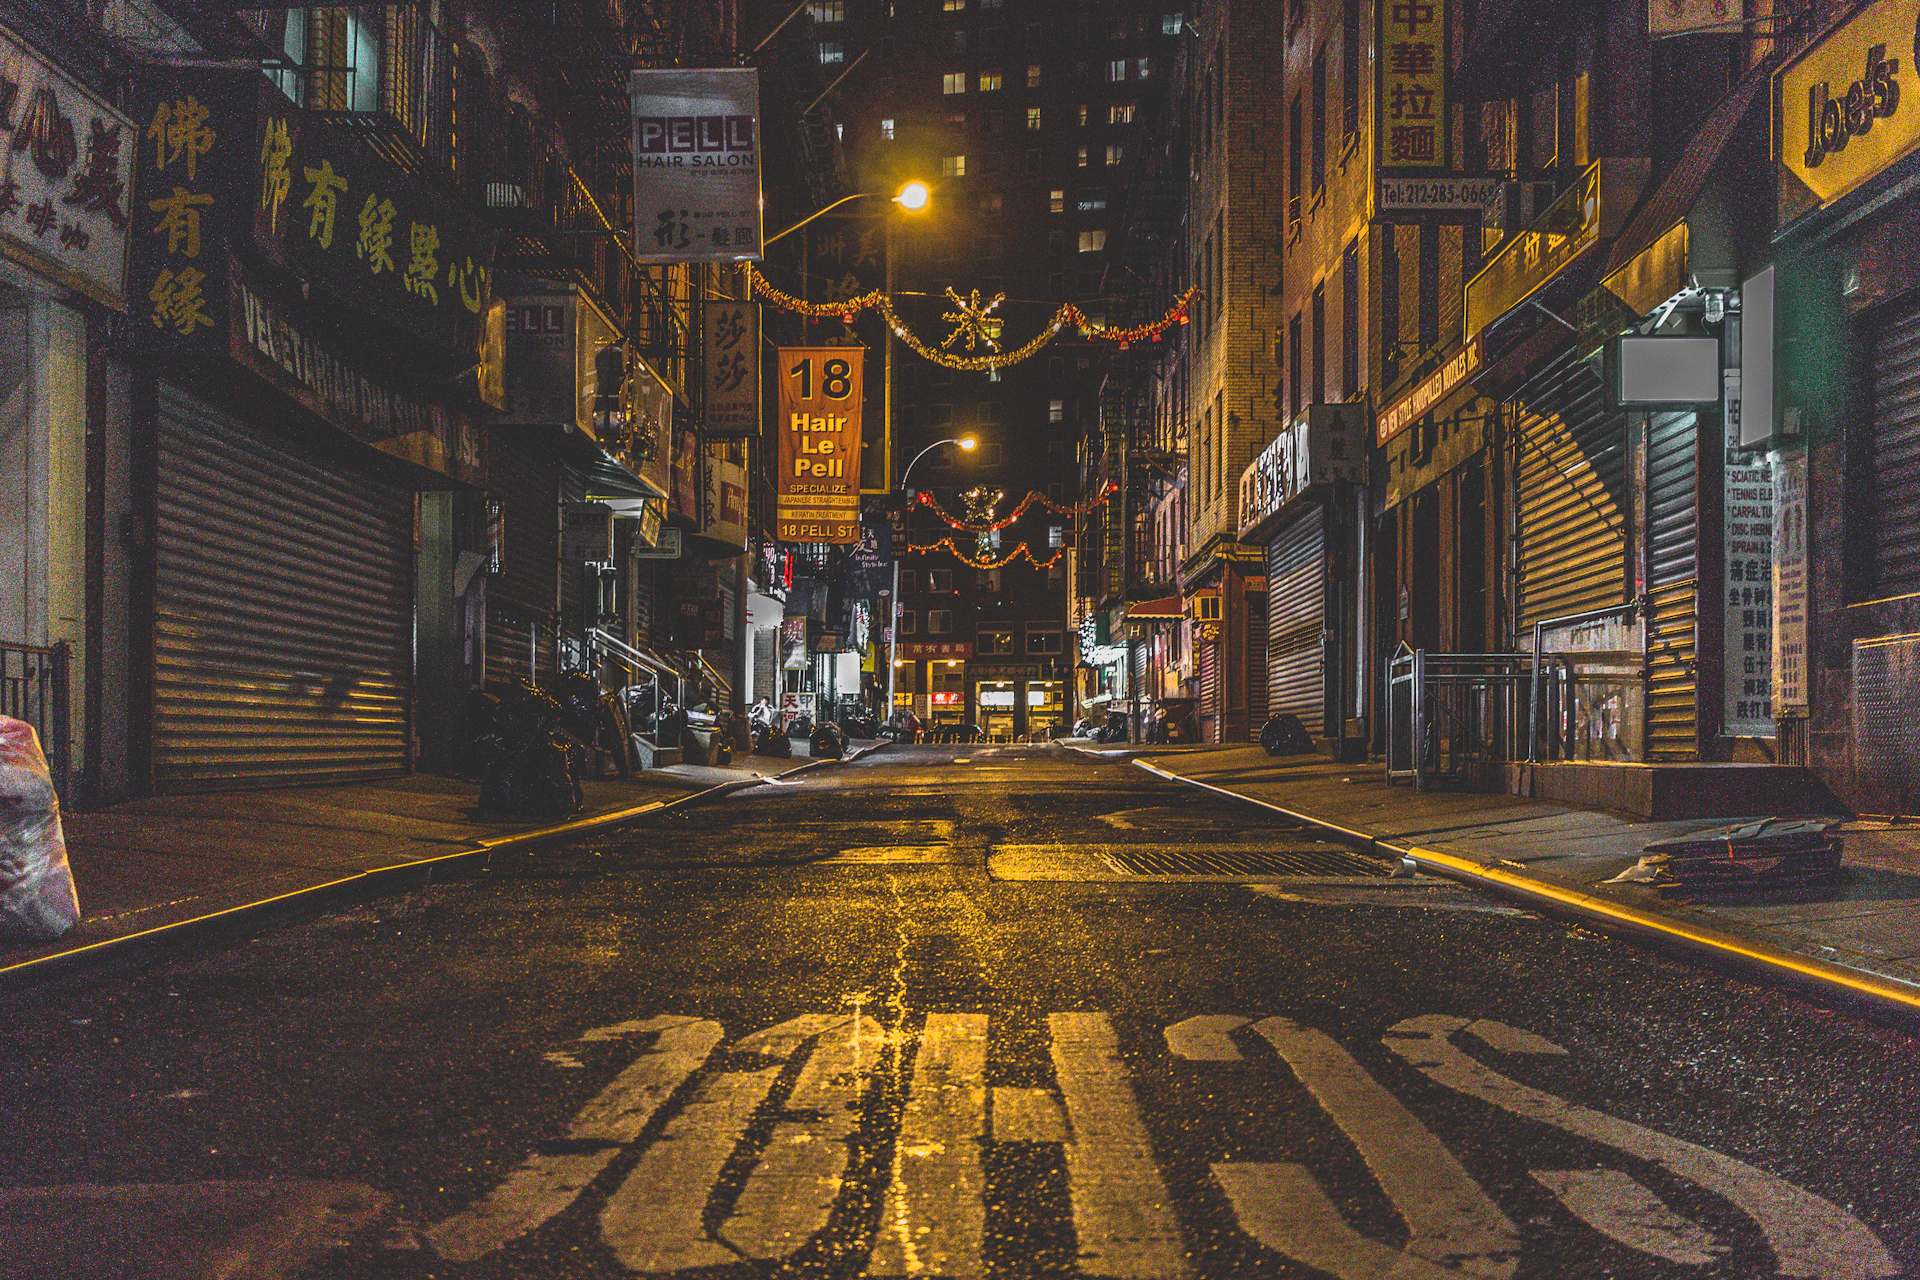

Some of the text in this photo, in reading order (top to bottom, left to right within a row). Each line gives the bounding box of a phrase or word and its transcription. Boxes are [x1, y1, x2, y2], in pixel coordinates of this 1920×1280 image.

[642, 121, 748, 149] PELL
[639, 154, 754, 168] HAIR SALON
[1383, 184, 1405, 204] Tel:
[146, 96, 218, 336] 佛有緣
[791, 358, 854, 402] 18
[1443, 352, 1466, 391] NOODLES
[790, 412, 849, 433] Hair
[802, 435, 835, 455] Le
[794, 458, 844, 478] Pell
[1731, 470, 1759, 483] SCIATIC
[789, 484, 848, 495] SPECIALIZE
[1732, 488, 1758, 501] TENNIS
[1731, 506, 1760, 519] CARPAL
[782, 524, 855, 538] 18 PELL ST
[1731, 523, 1749, 536] DISC
